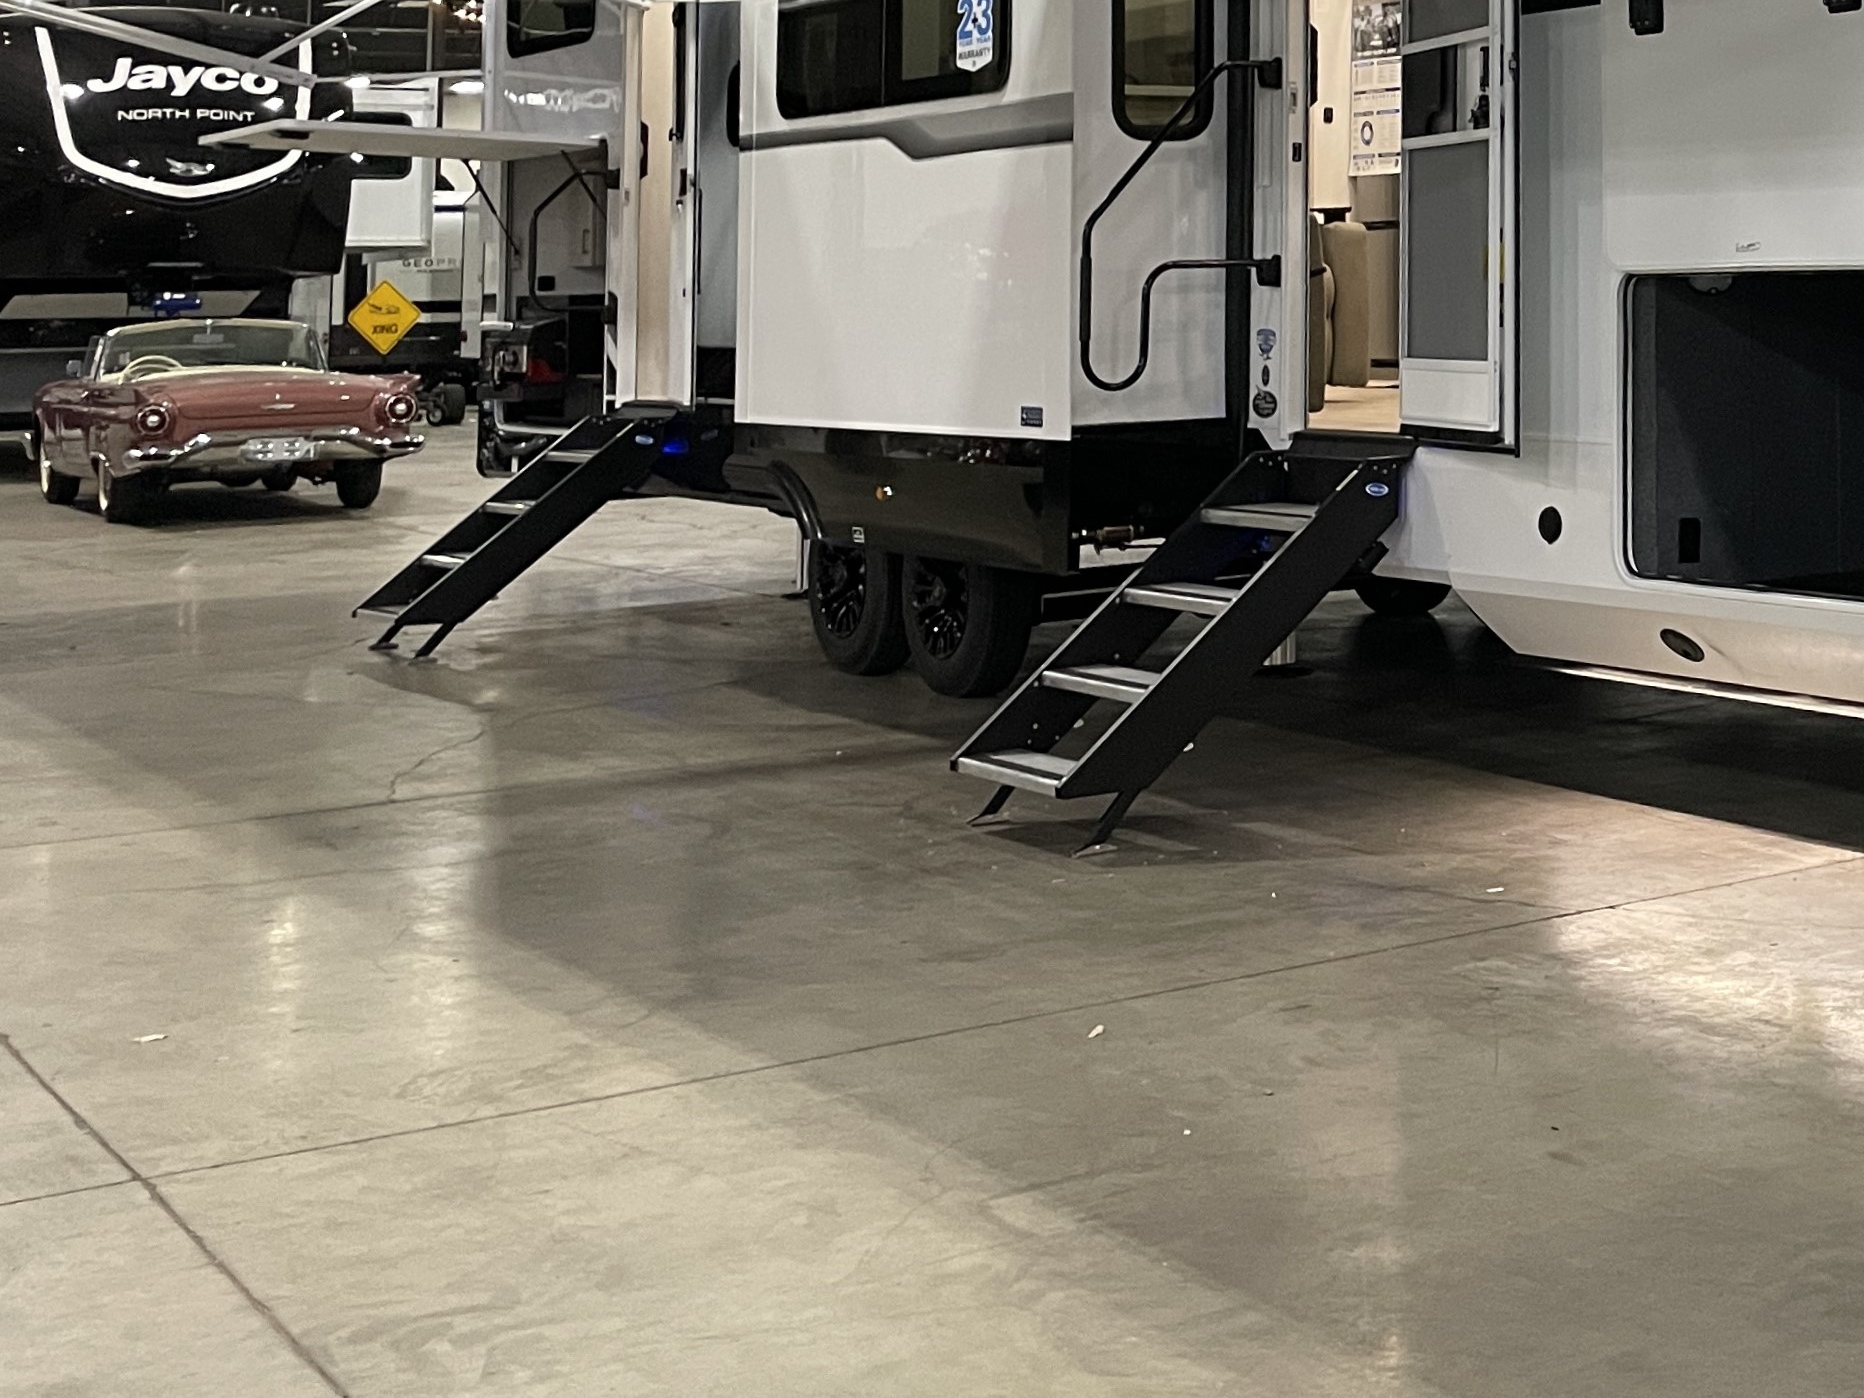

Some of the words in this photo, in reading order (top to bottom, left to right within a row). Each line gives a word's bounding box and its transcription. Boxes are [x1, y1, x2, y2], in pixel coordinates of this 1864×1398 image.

[86, 57, 279, 97] Jayco
[117, 108, 190, 121] NORTH
[196, 108, 255, 122] POINT
[402, 258, 460, 267] GEOPR
[372, 323, 398, 334] XING
